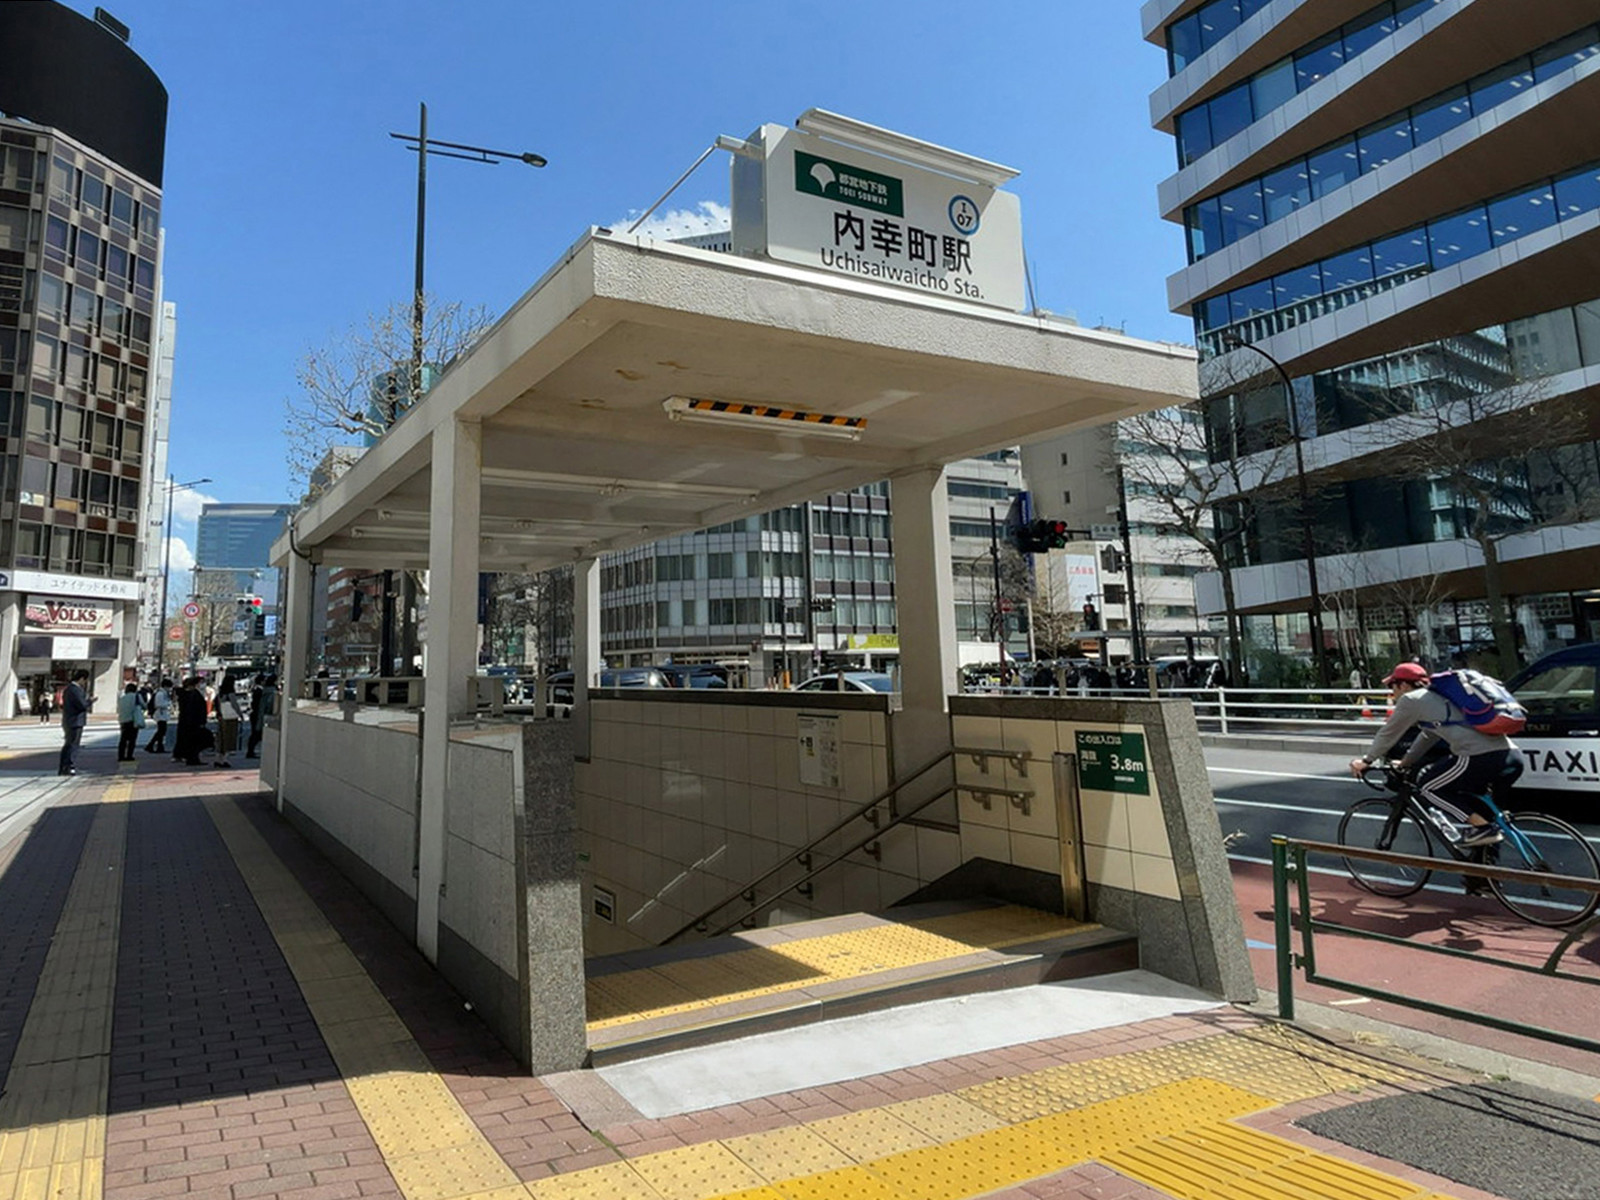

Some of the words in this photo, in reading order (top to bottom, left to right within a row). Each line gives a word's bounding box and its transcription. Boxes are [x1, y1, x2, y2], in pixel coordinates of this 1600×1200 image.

[858, 191, 887, 206] SUBWAY
[957, 213, 973, 227] 07
[833, 210, 973, 275] 内幸町駅
[821, 247, 949, 292] Uchisaiwaicho
[954, 278, 985, 300] Sta.
[45, 601, 97, 624] VOLKS
[1109, 753, 1144, 772] 3.8m
[1522, 749, 1598, 774] TAXI
